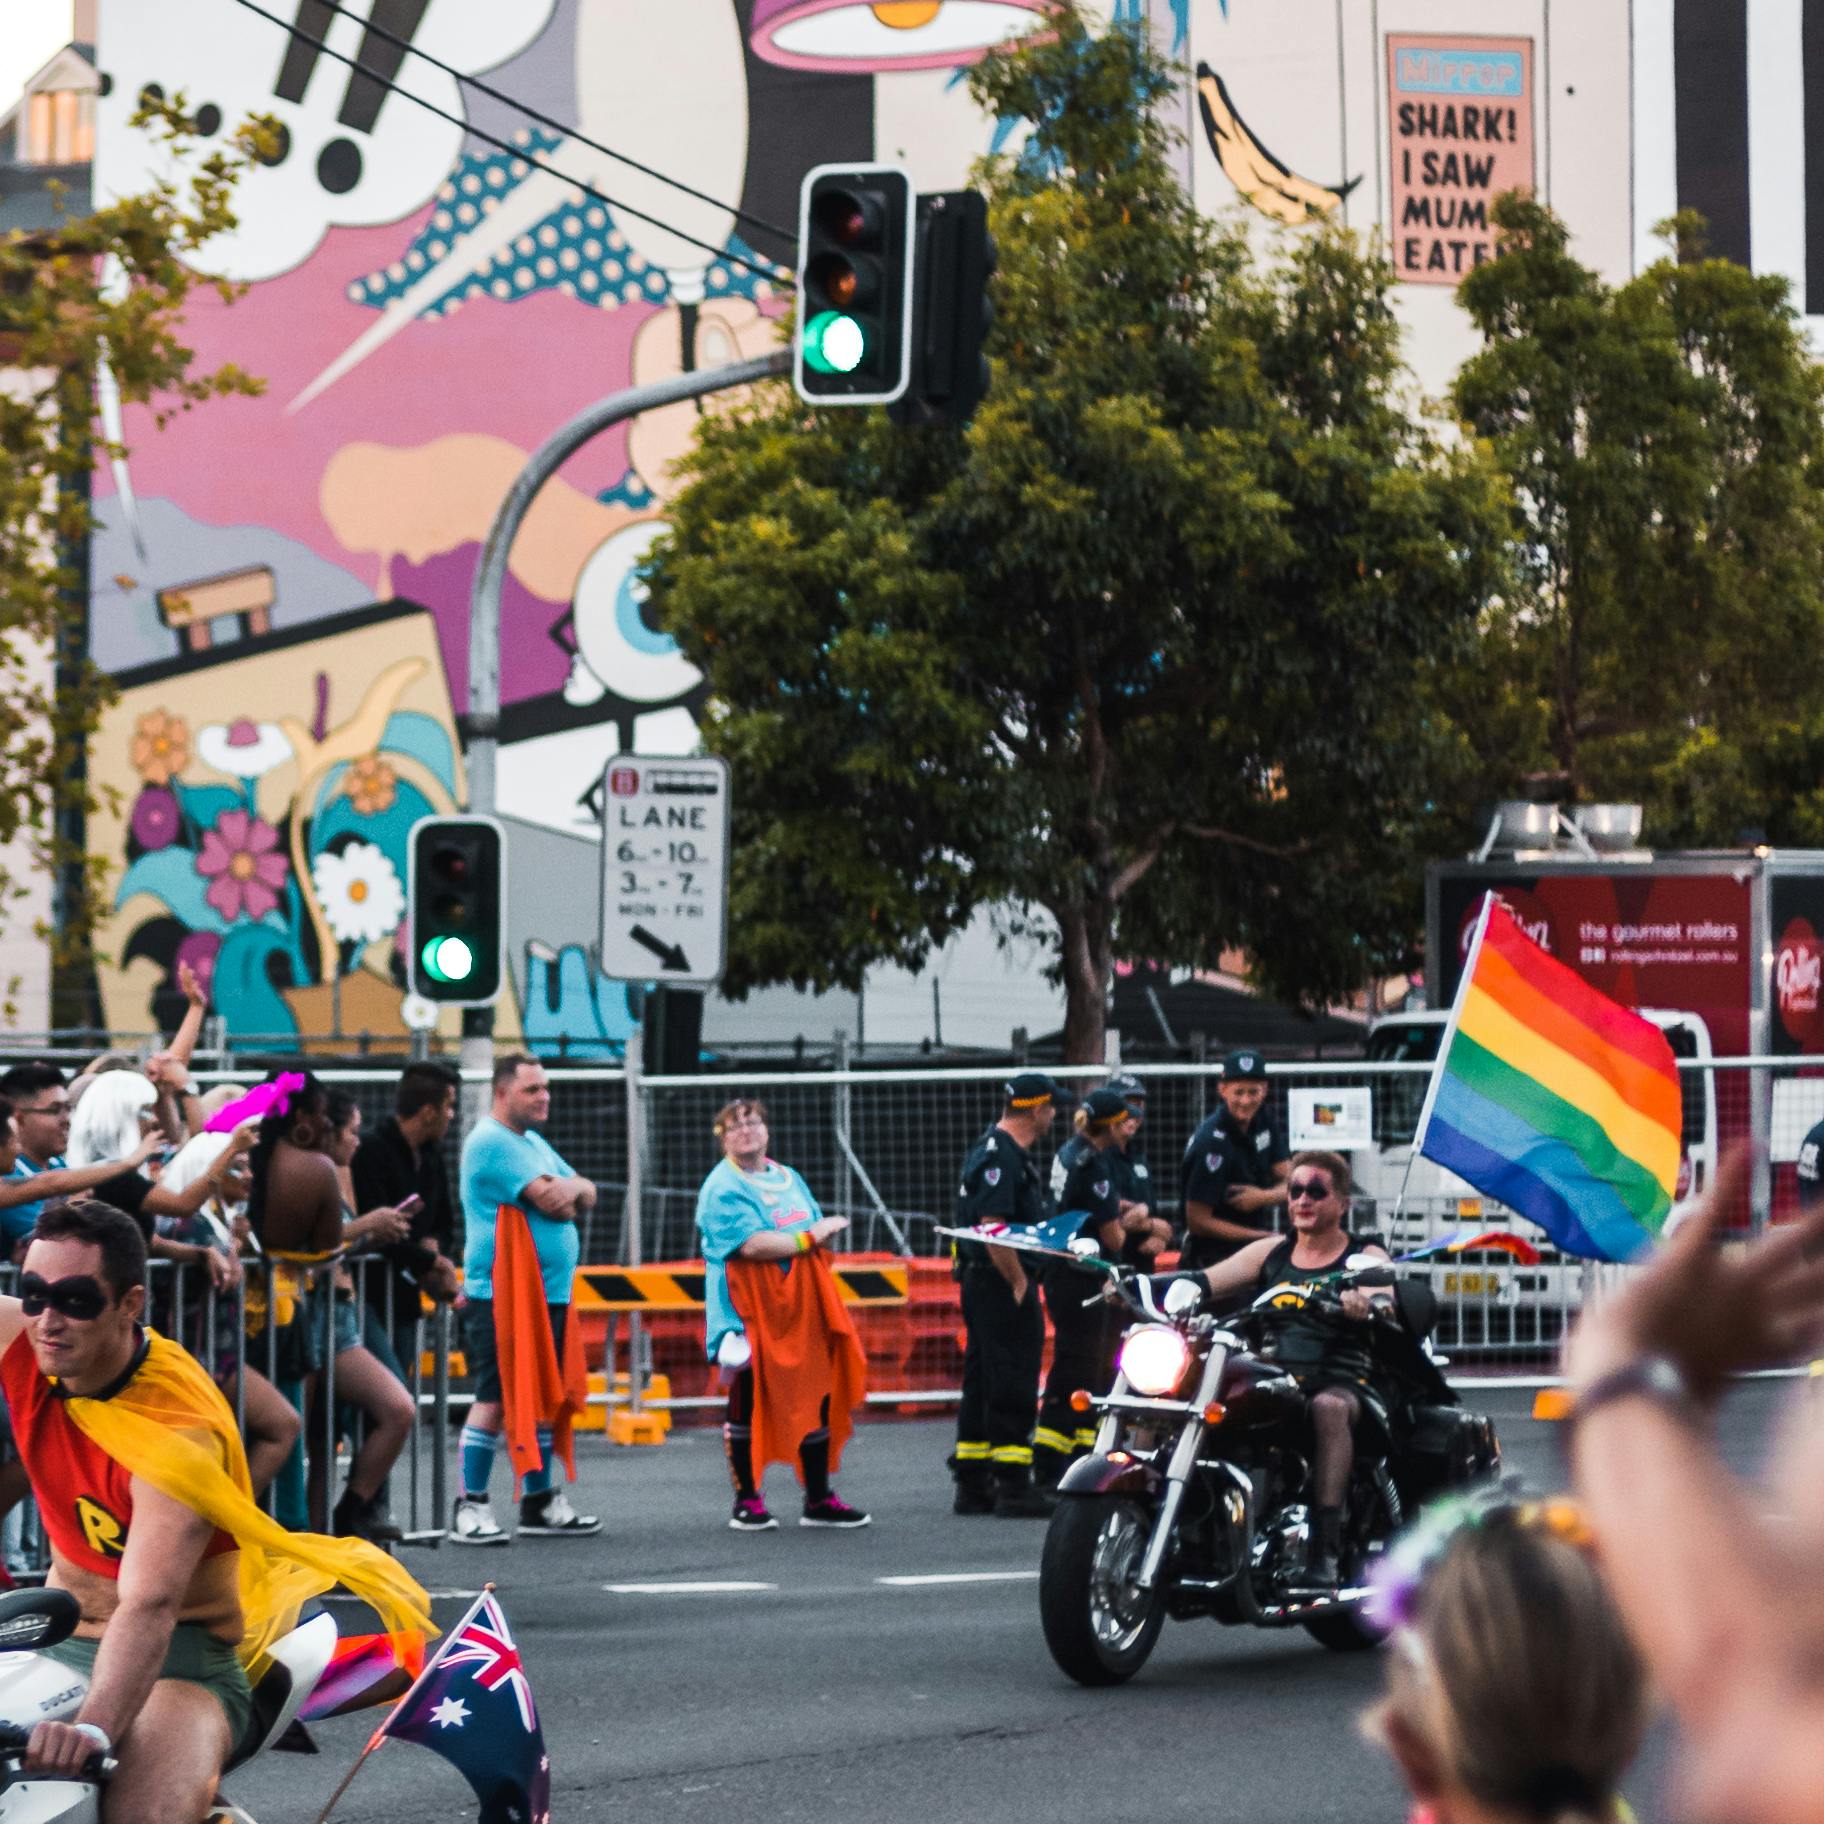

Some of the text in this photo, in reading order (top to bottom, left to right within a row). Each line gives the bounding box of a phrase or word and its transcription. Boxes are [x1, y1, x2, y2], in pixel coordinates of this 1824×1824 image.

[1398, 102, 1517, 143] SHARK!
[1403, 150, 1495, 188] I SAW
[1402, 196, 1489, 231] MUM
[620, 806, 707, 830] LANE
[1580, 921, 1738, 944] the gourmet rollers
[75, 1497, 125, 1554] R
